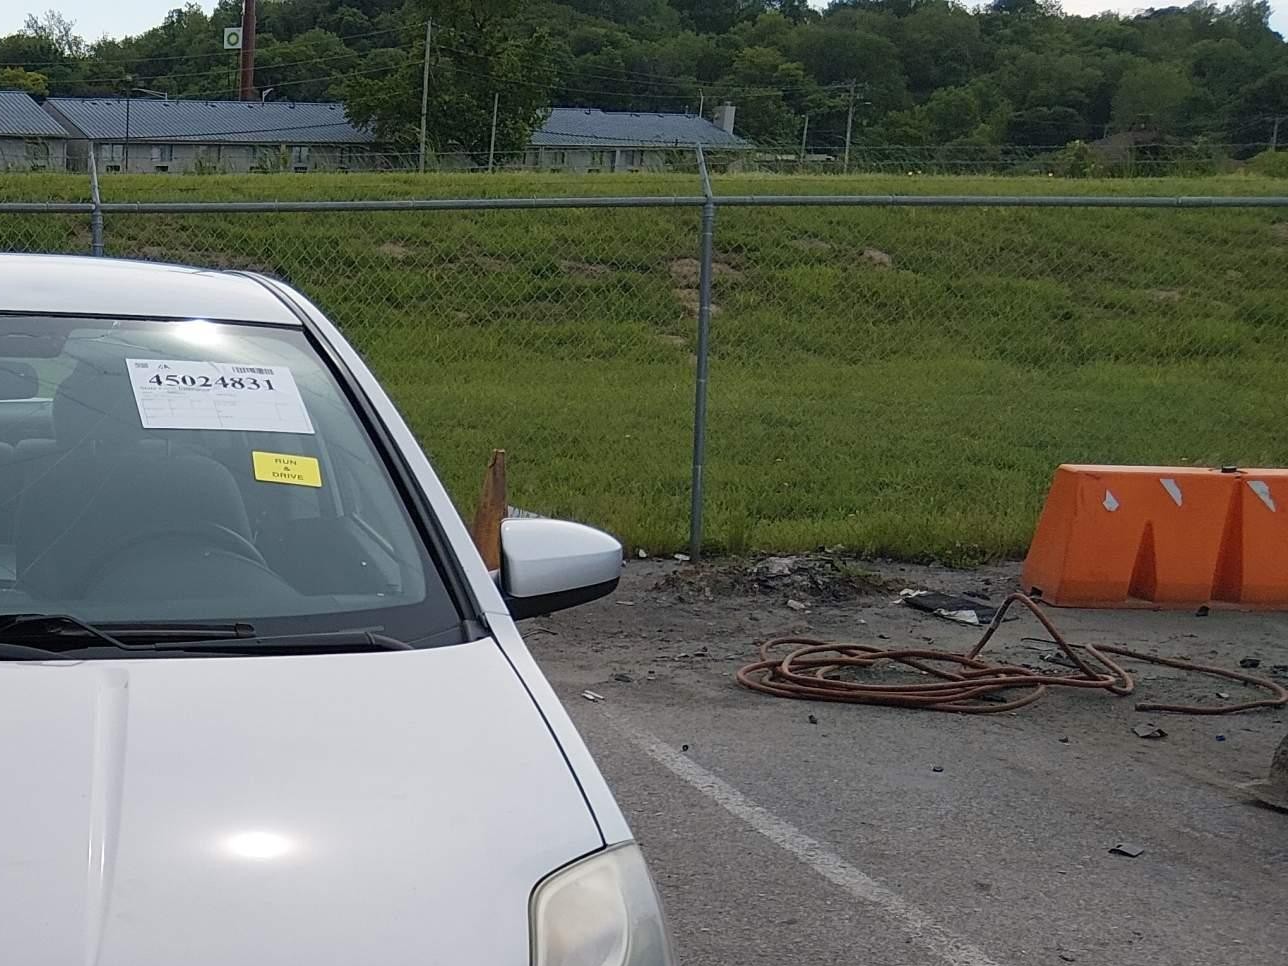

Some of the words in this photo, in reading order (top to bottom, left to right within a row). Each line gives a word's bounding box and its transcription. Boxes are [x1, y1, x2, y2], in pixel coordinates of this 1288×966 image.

[148, 373, 277, 391] 45024831
[274, 458, 297, 466] RUN
[272, 471, 304, 481] DRIVE
